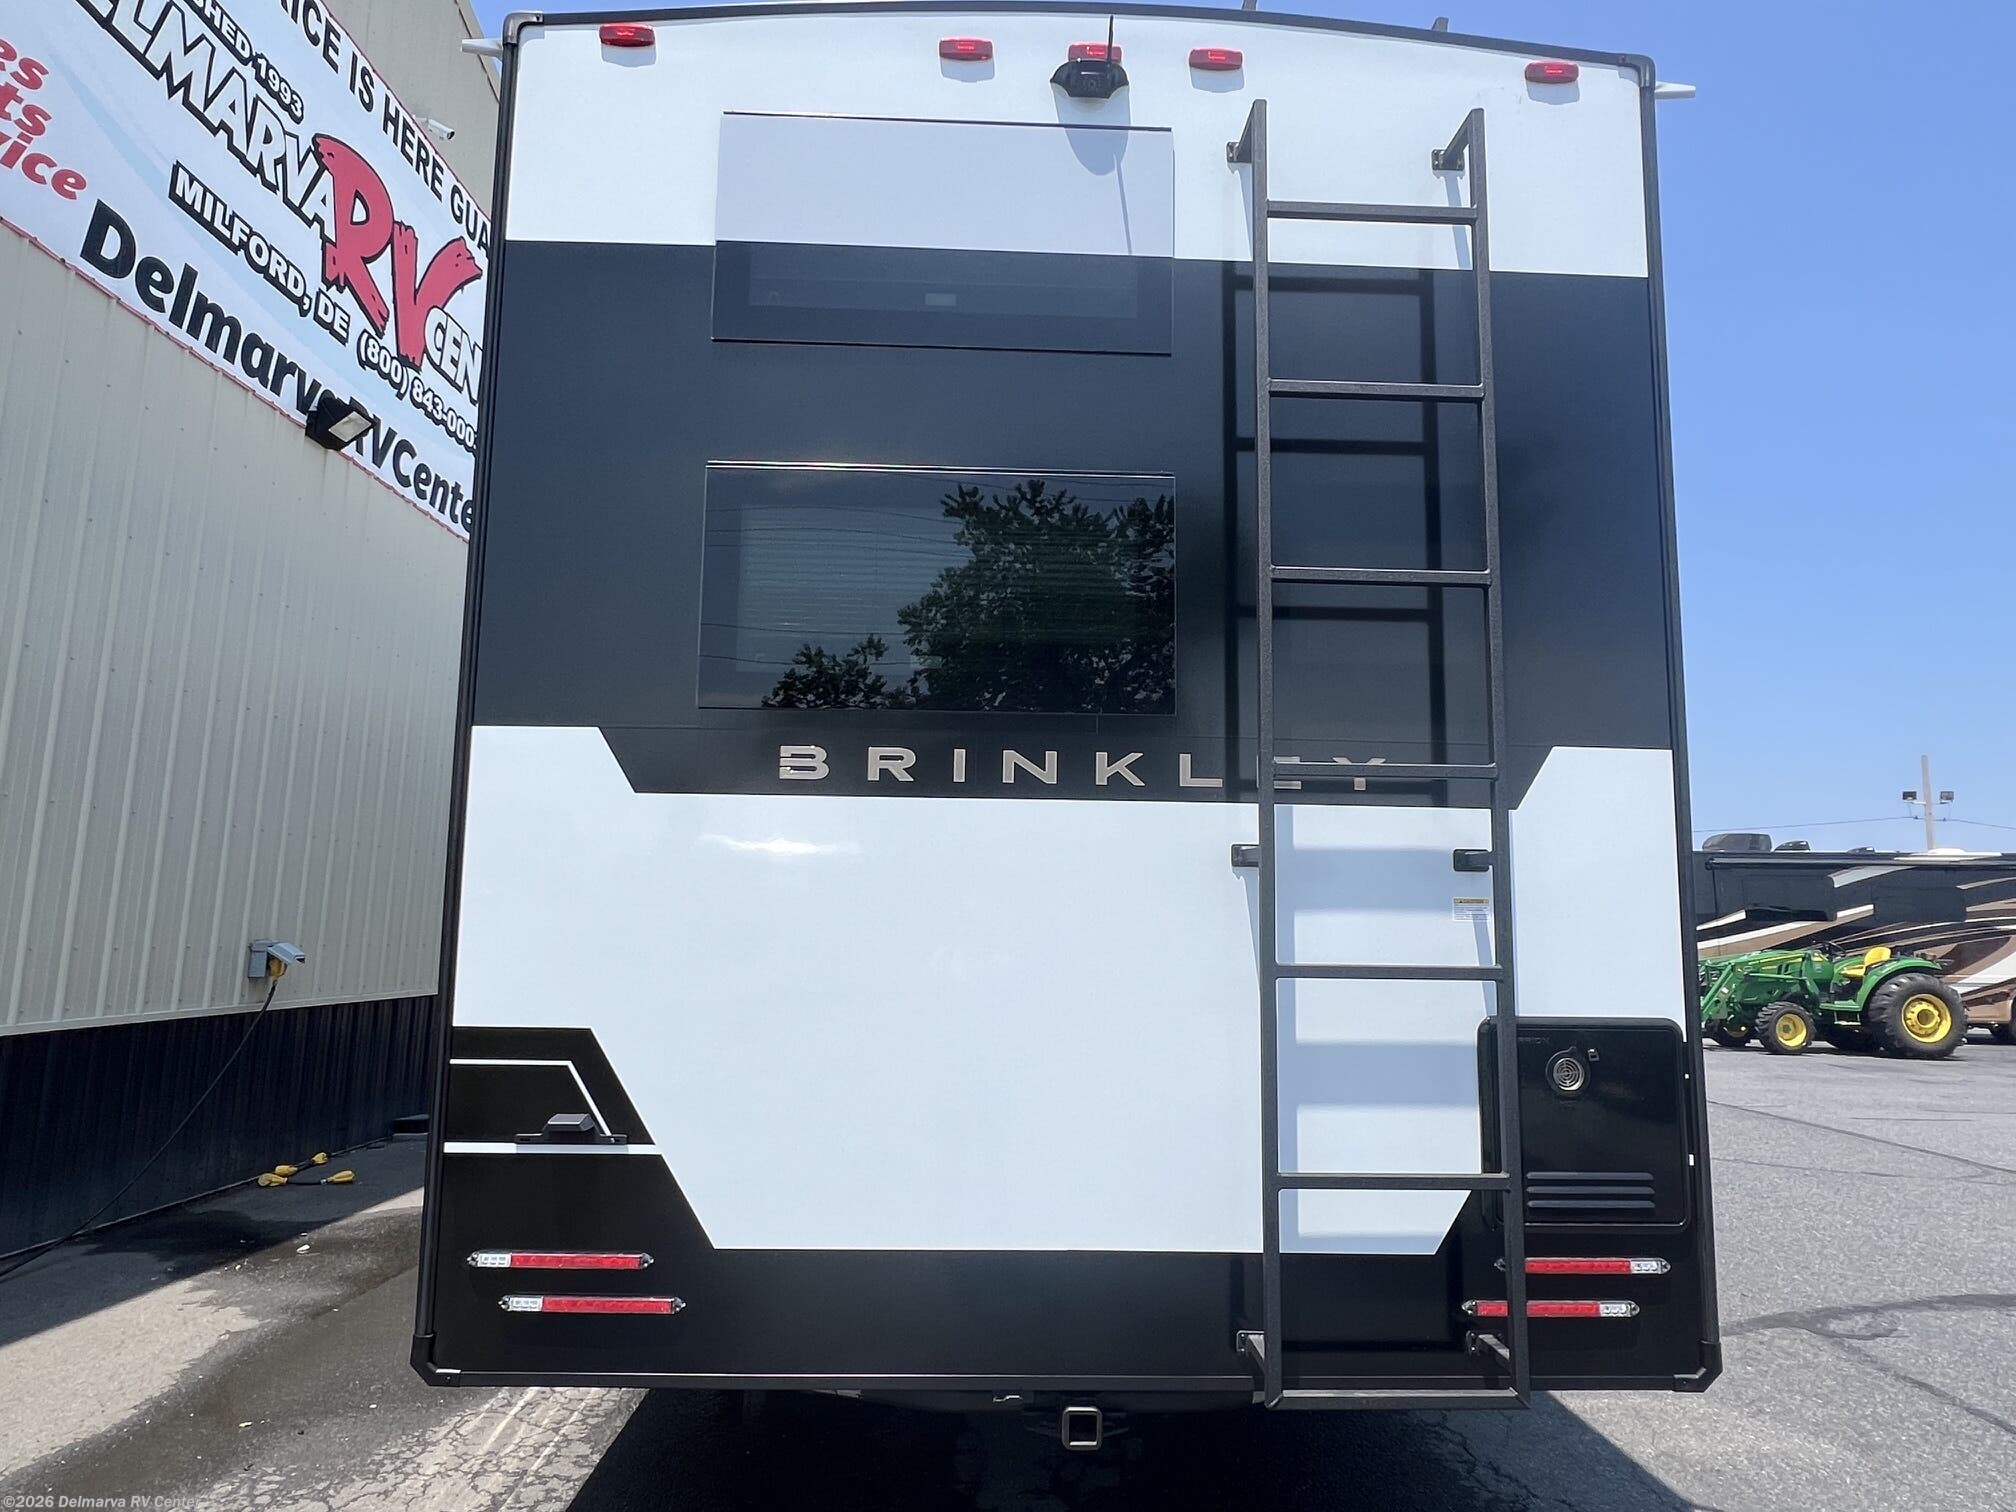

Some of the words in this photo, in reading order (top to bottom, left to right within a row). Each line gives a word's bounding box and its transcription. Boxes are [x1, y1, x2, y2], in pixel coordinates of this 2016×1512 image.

[196, 0, 253, 64] HED
[253, 53, 304, 123] 1993
[281, 0, 341, 74] ICE
[350, 51, 375, 113] IS
[383, 93, 444, 203] HERE
[0, 131, 87, 200] ice
[312, 131, 483, 372] RV
[169, 160, 312, 317] MILFORD,
[313, 288, 351, 346] DE
[357, 329, 408, 400] (800)
[410, 376, 478, 451] 843-000
